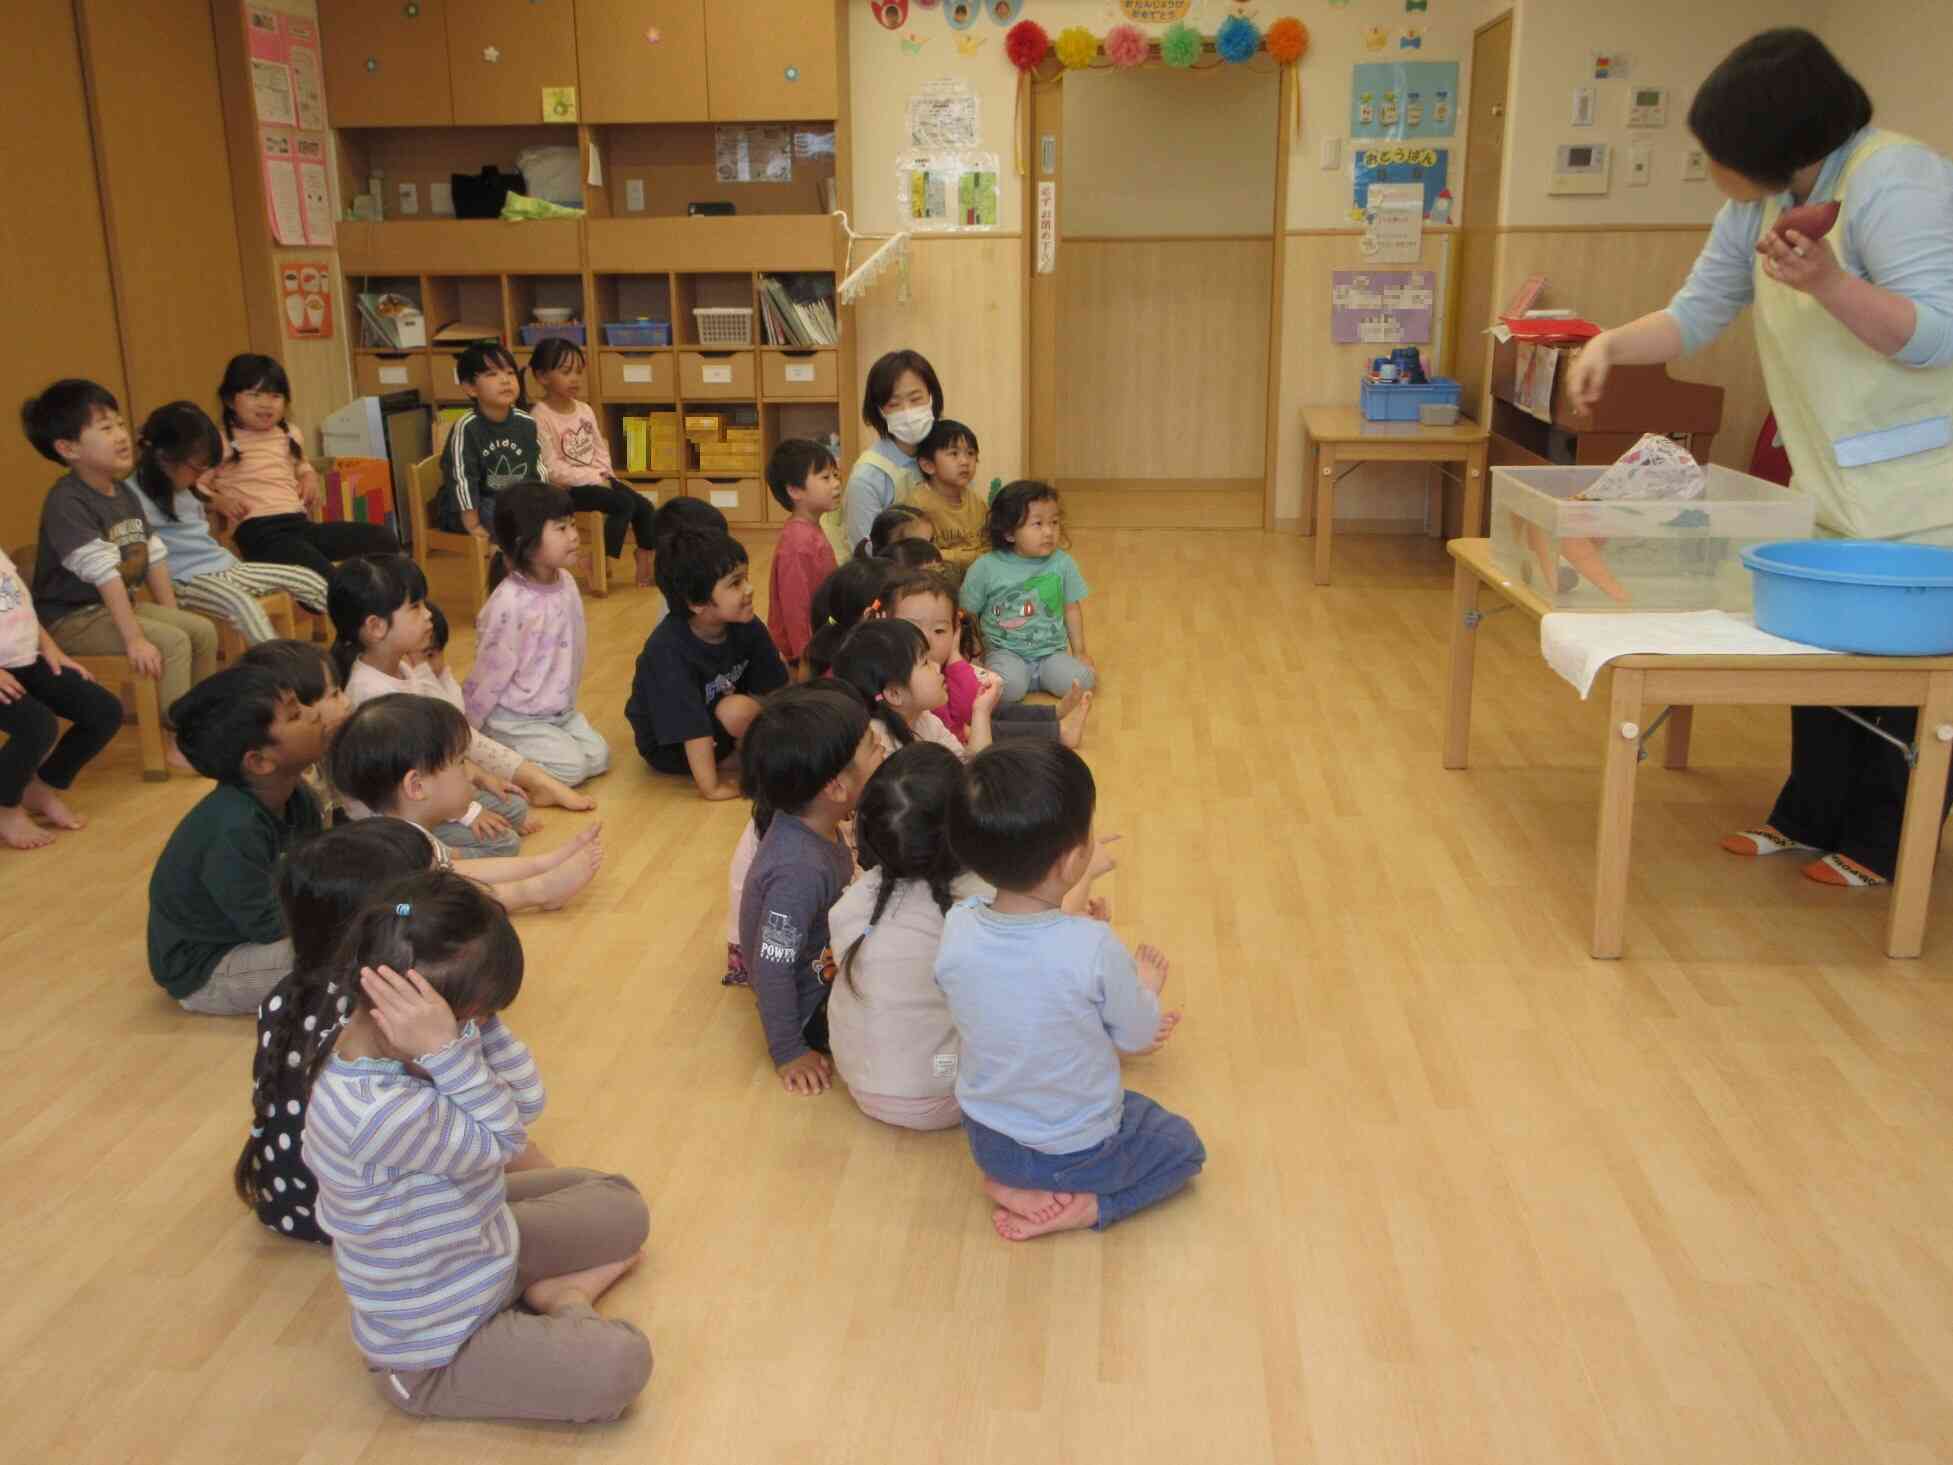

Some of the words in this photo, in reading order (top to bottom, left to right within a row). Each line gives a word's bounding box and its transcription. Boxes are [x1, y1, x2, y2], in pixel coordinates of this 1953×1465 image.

[1365, 148, 1433, 165] おとうばん
[482, 439, 522, 457] adidas
